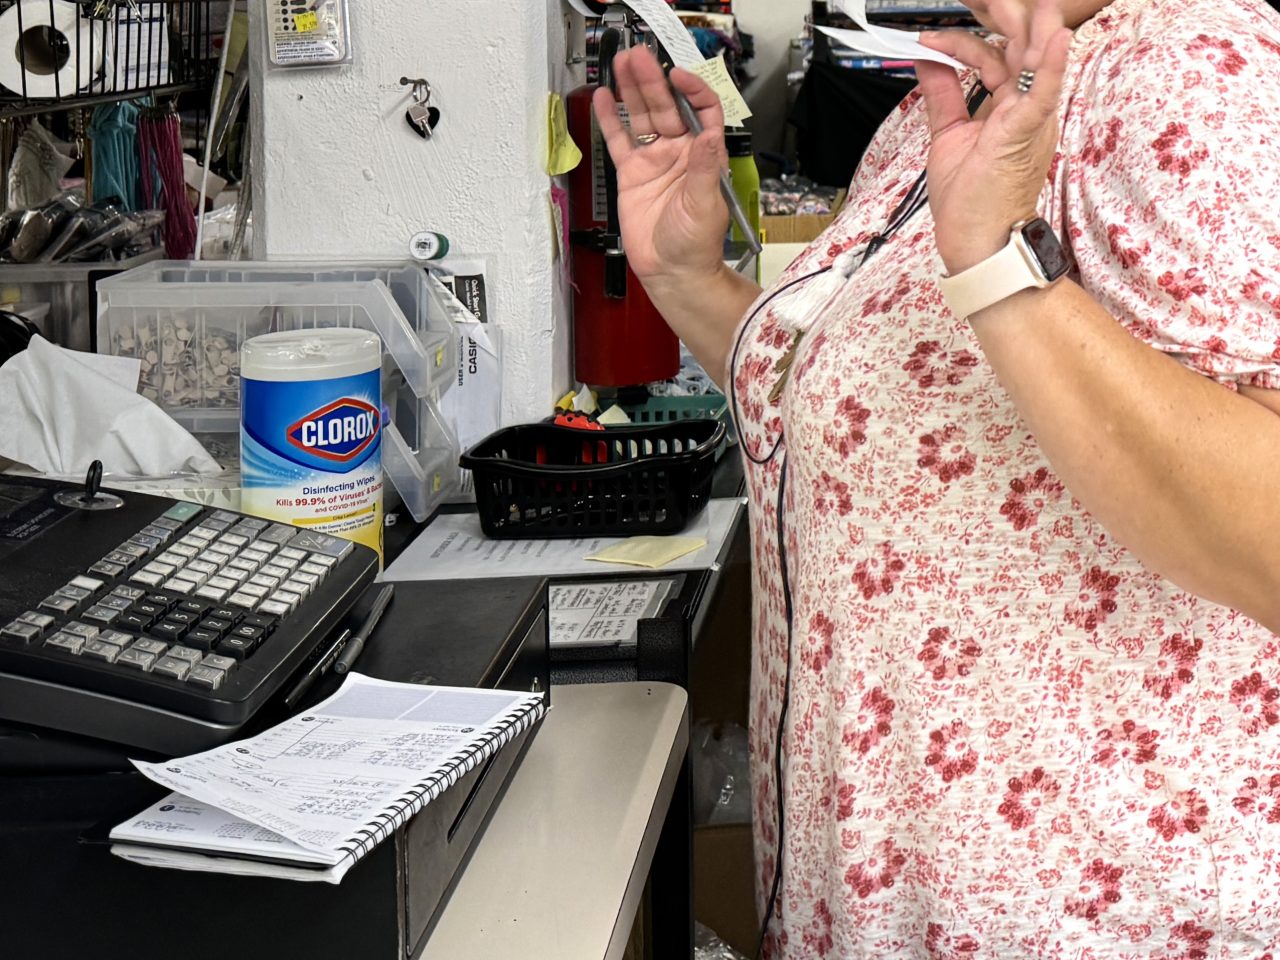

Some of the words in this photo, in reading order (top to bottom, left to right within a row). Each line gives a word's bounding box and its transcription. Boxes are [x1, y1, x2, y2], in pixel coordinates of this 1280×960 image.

[302, 410, 375, 447] CLOROX
[303, 481, 355, 496] Disinfecting
[356, 474, 376, 487] Wipes
[276, 498, 293, 507] Kills
[295, 496, 326, 507] 99.9%
[328, 495, 337, 504] of
[315, 505, 328, 514] and
